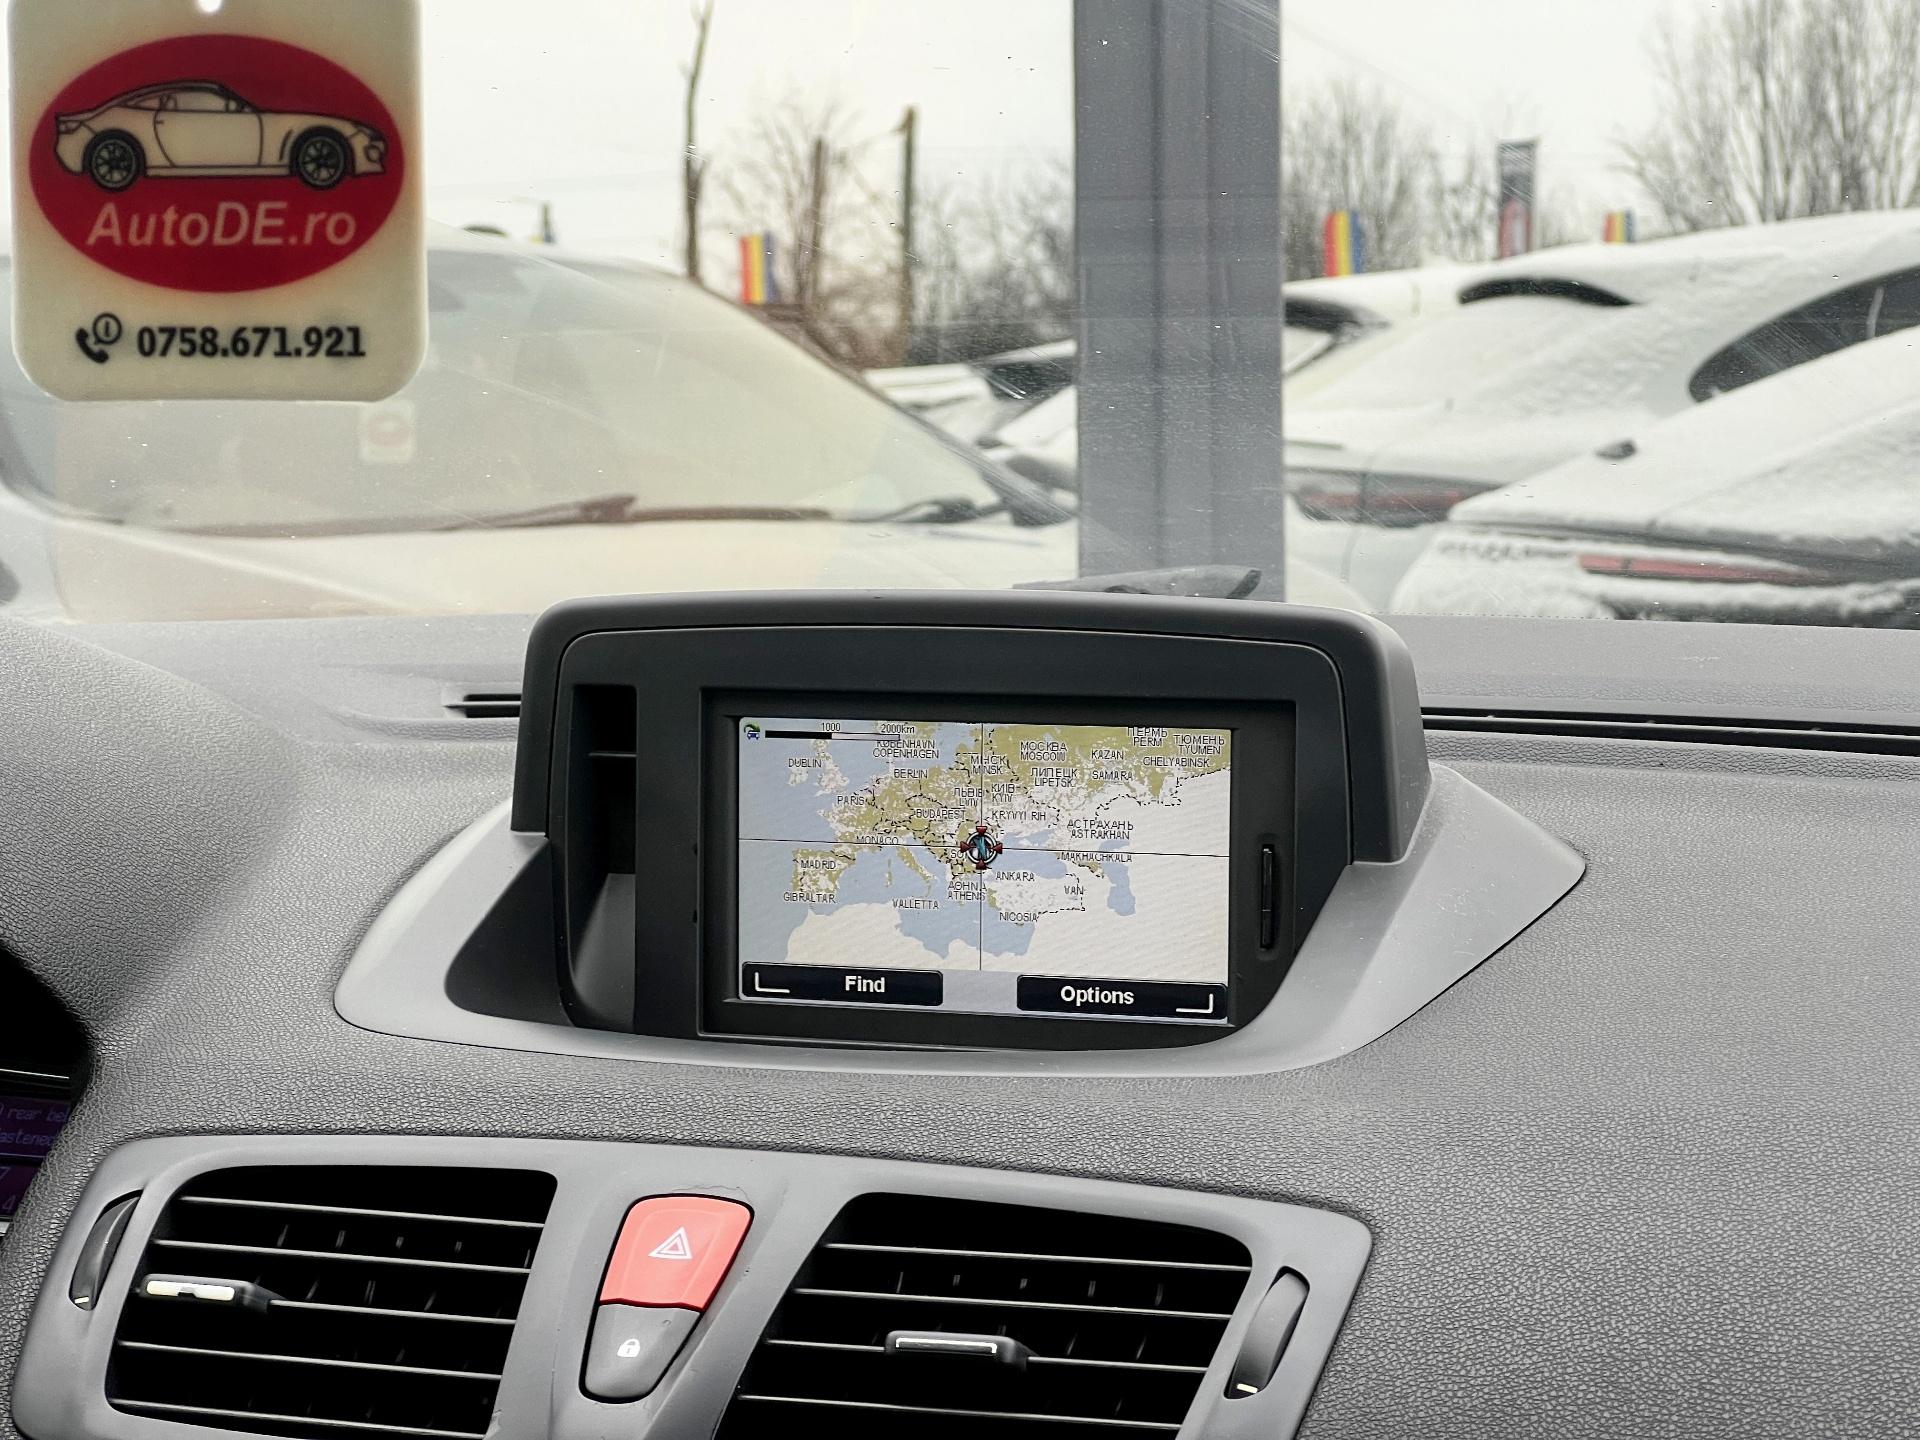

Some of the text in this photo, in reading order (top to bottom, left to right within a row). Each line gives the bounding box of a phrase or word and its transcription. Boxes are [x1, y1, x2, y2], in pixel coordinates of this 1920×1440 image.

[86, 200, 357, 247] AutoDE.ro
[136, 325, 366, 358] 0758.671.921
[820, 722, 841, 732] 1000
[880, 723, 915, 734] 2000km
[1020, 741, 1067, 752] МОСКВА
[1133, 736, 1163, 747] PERM
[872, 748, 939, 759] COPENHAGEN
[1091, 749, 1125, 760] KAZAN
[1179, 744, 1221, 755] TYUMEN
[1020, 751, 1066, 762] MOSCOW
[1143, 756, 1210, 768] CHELYABINSK
[788, 758, 822, 768] DUBLIN
[893, 768, 928, 779] BERLIN
[1030, 767, 1078, 778] ЛИПЕЦК
[1092, 770, 1134, 781] SAMARA
[1034, 776, 1073, 787] LIPETSK
[837, 795, 865, 806] PARIS
[915, 808, 966, 820] BUDAPEST
[1031, 811, 1046, 821] RIH
[1066, 819, 1134, 831] АСТРАХАНЬ
[1070, 829, 1131, 840] ASTRAKHAN
[856, 836, 899, 845] MONACO
[1061, 852, 1133, 863] MAKHACHKALA
[800, 859, 836, 870] MADRID
[995, 871, 1035, 882] ANKARA
[947, 891, 986, 901] ATHENS
[1063, 885, 1084, 896] VAN
[783, 892, 836, 904] GIBRALTAR
[892, 899, 940, 910] VALLETTA
[999, 911, 1038, 922] NICOSIA
[844, 975, 886, 994] Find
[1060, 984, 1135, 1008] Options
